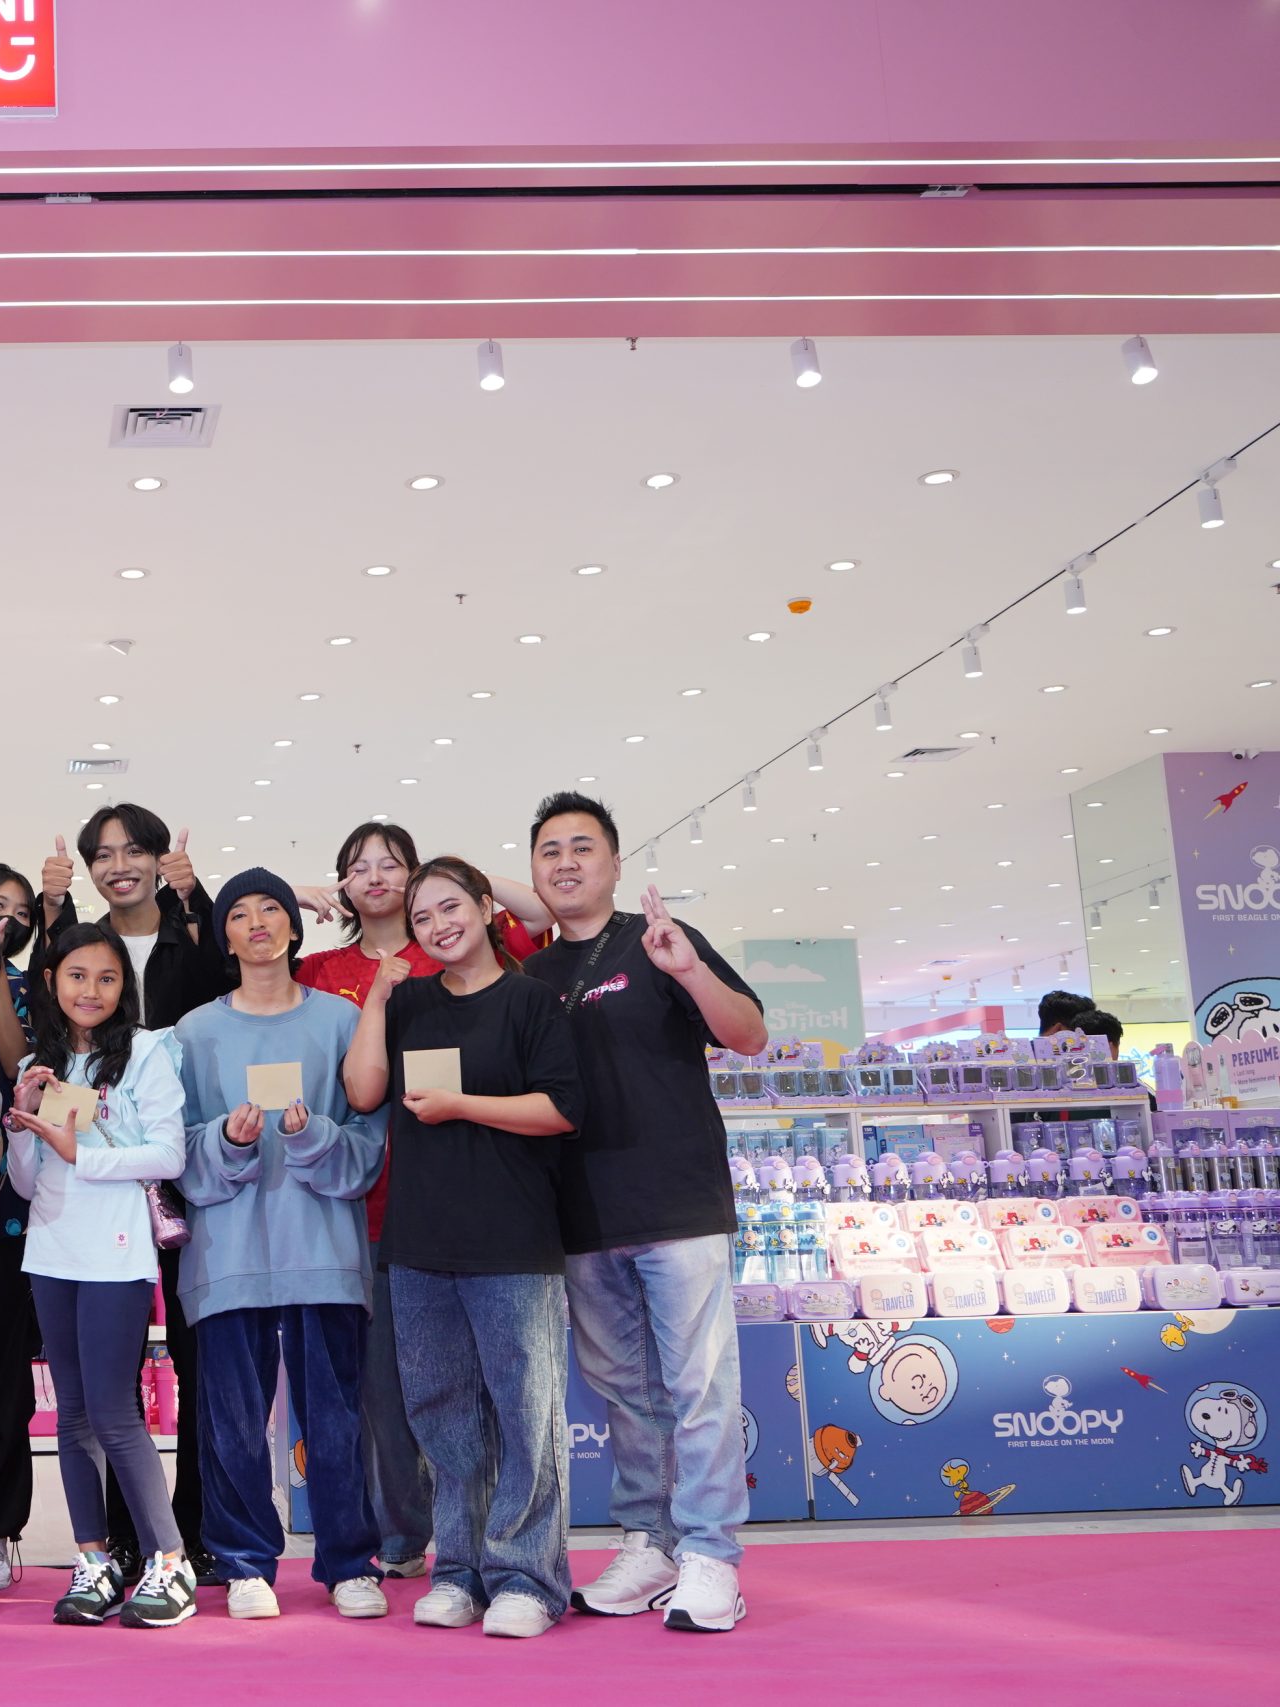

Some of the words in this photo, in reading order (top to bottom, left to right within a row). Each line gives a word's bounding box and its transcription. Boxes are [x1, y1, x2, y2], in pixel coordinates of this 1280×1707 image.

[1212, 914, 1235, 922] FIRST
[1232, 1046, 1279, 1067] PERFUME
[882, 1293, 915, 1312] TRAVELER
[1094, 1287, 1128, 1306] TRAVELER
[993, 1409, 1124, 1438] SNOOPY
[1075, 1438, 1089, 1446] THE
[1090, 1437, 1115, 1445] MOON
